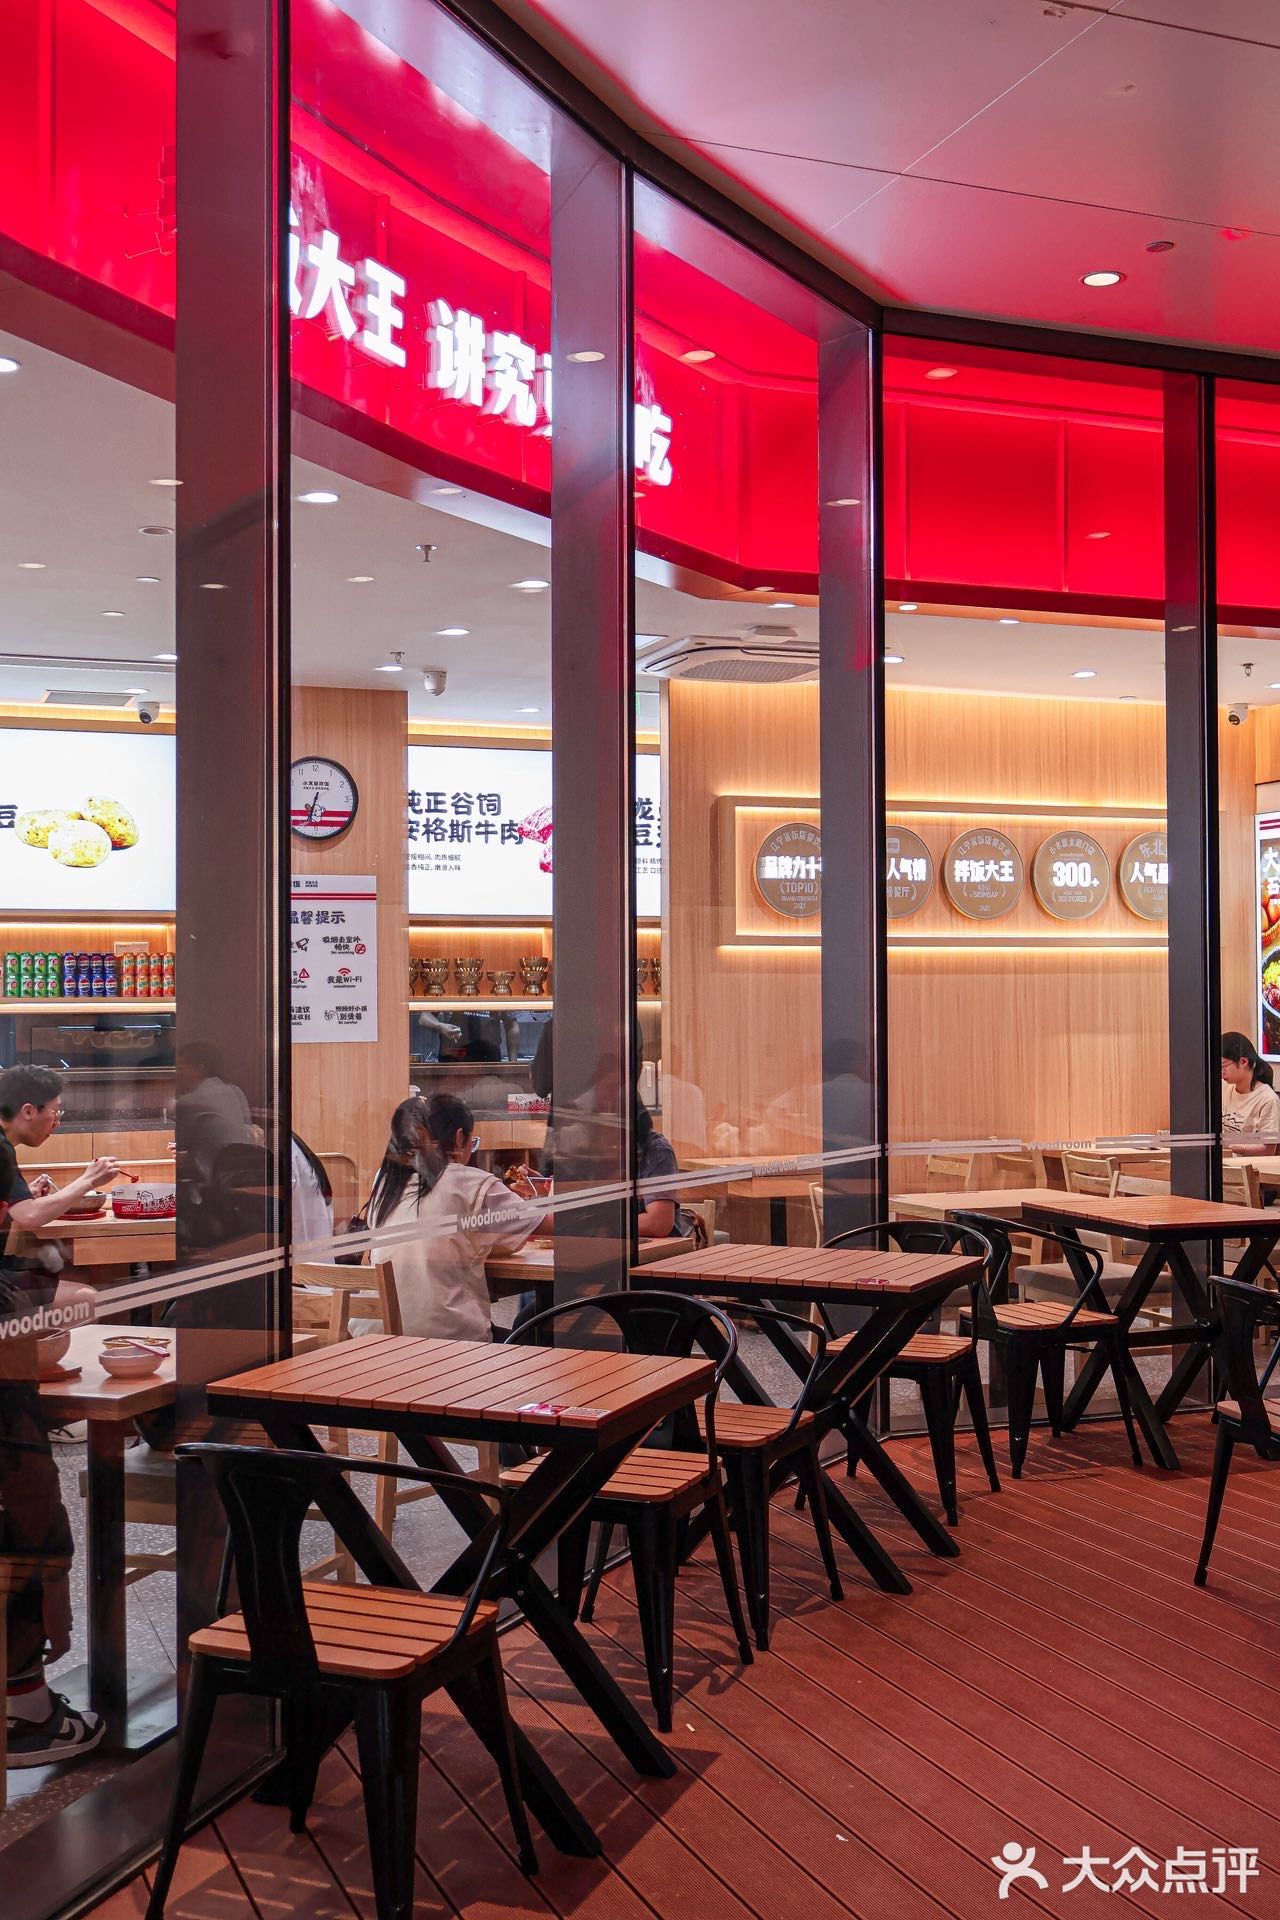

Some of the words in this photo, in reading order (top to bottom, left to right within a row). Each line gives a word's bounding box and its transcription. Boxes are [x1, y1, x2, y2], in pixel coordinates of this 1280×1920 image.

[430, 298, 552, 437] 讲究
[297, 768, 304, 776] 11
[312, 764, 319, 772] 12
[339, 780, 345, 788] 2
[344, 795, 350, 803] 3
[1139, 838, 1167, 858] 东北
[762, 856, 822, 879] 品牌力十
[954, 860, 1015, 882] 拌饭大王
[1052, 861, 1099, 888] 300+
[461, 1208, 517, 1229] woodroom
